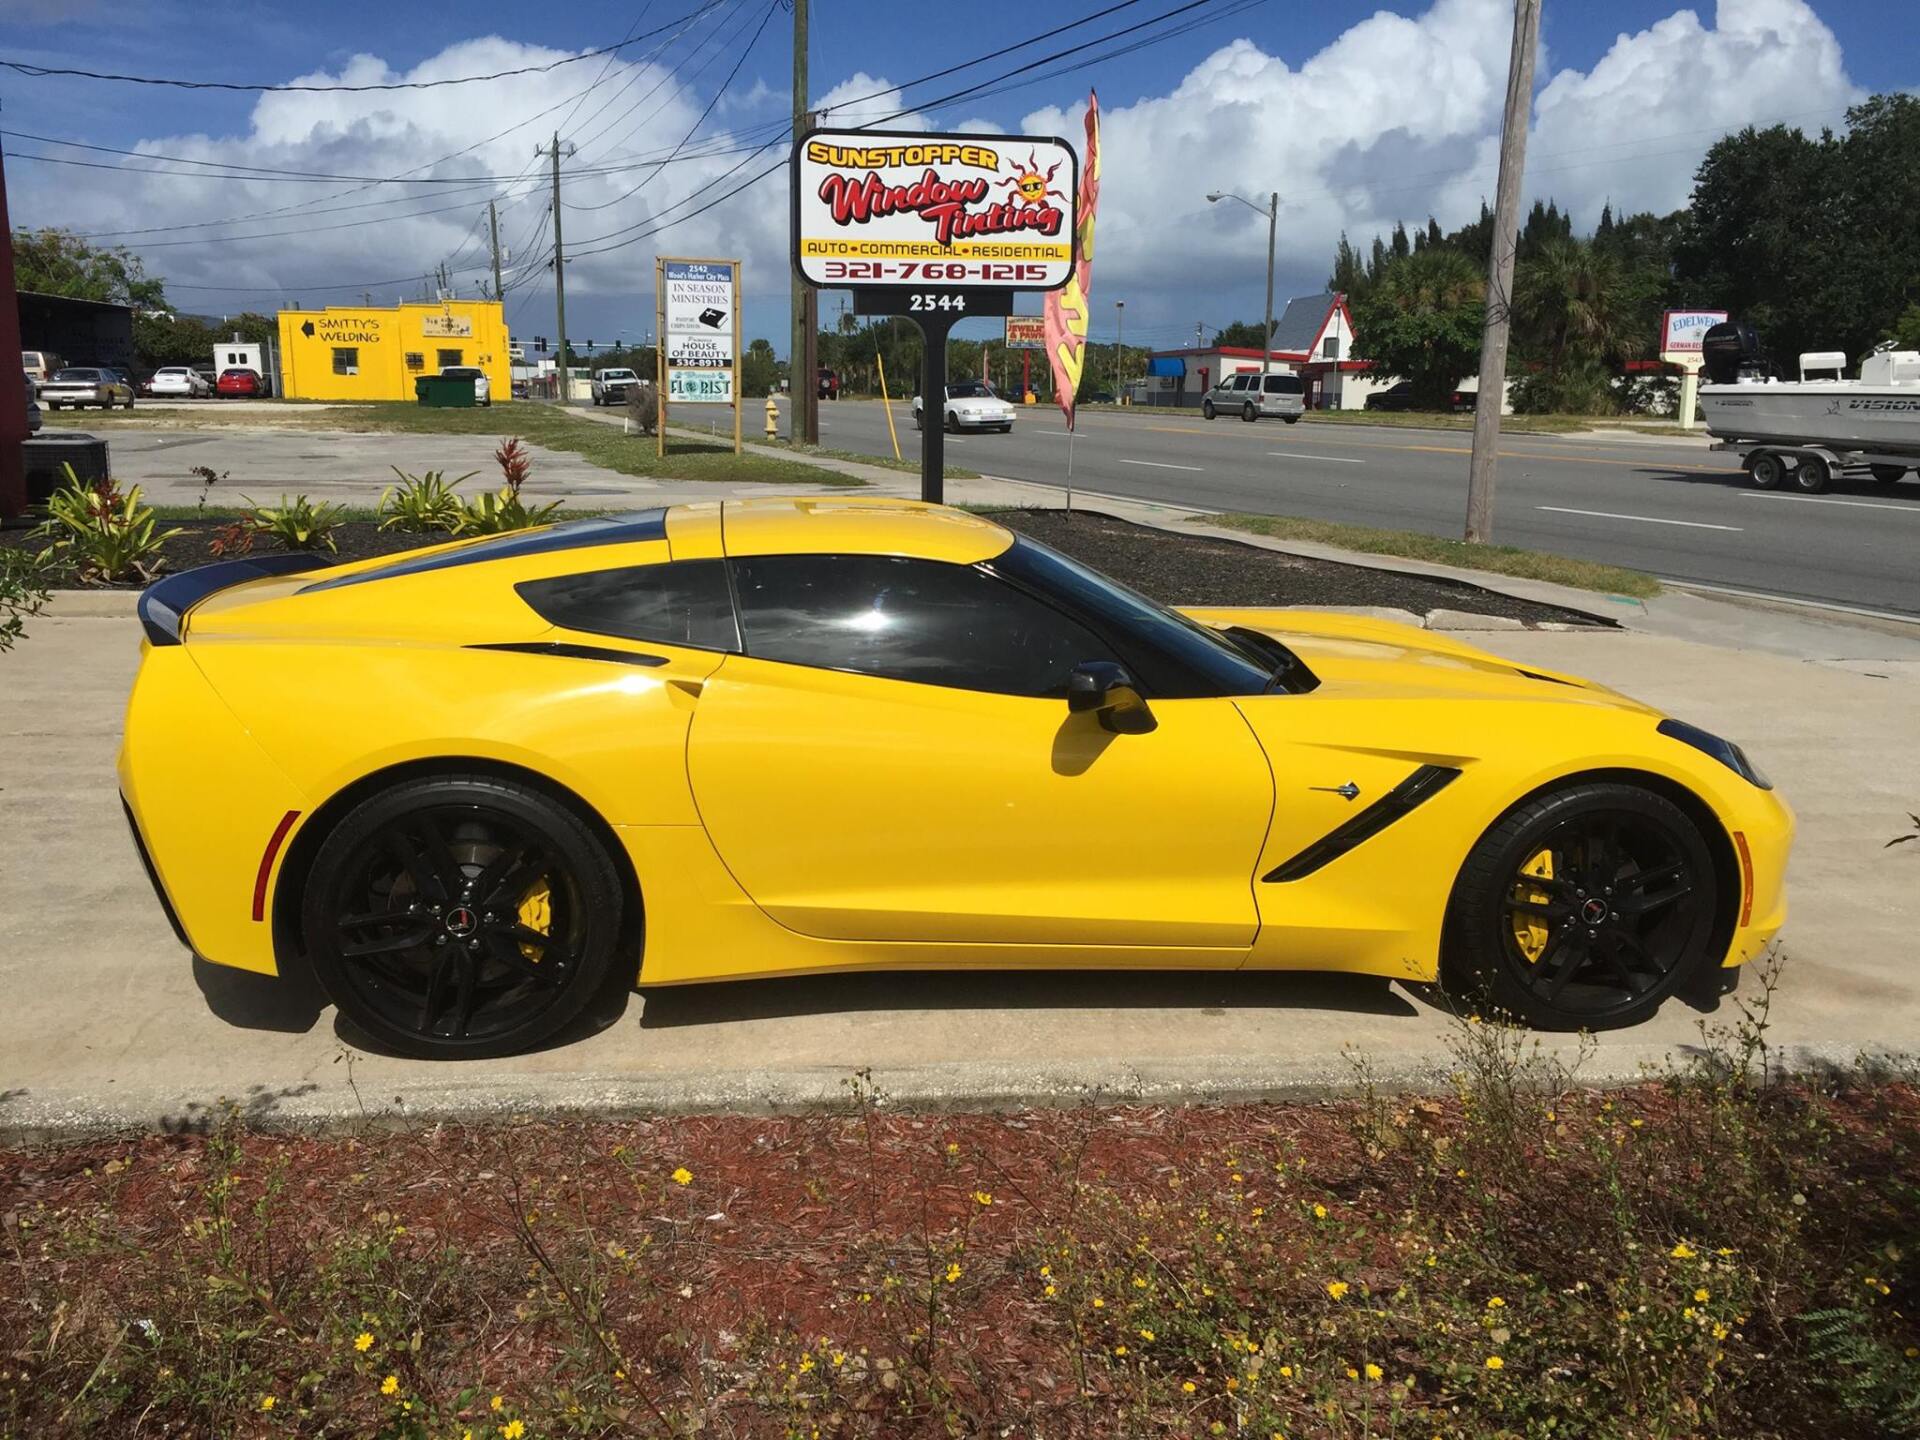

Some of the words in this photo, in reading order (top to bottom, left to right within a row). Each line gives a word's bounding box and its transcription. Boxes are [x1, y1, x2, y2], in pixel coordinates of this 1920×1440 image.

[807, 141, 999, 173] SUNSTOPPER
[818, 168, 989, 226] Window
[919, 201, 1064, 245] Tinting
[807, 242, 849, 254] AUTO
[860, 243, 962, 257] COMMERCIAL
[972, 246, 1063, 258] RESIDENTIAL
[825, 261, 1048, 281] 321-768-1215
[673, 283, 685, 292] IN
[687, 284, 726, 294] SEASON
[671, 294, 729, 304] MINISTRIES
[910, 294, 966, 312] 2544
[318, 318, 380, 330] SMITTY'S
[319, 331, 381, 343] WELDING
[682, 342, 718, 350] HOUSE
[1670, 341, 1692, 349] GERMAN
[688, 350, 728, 358] BEAUTY
[676, 358, 724, 367] 536-8913
[670, 379, 731, 395] FLORIST
